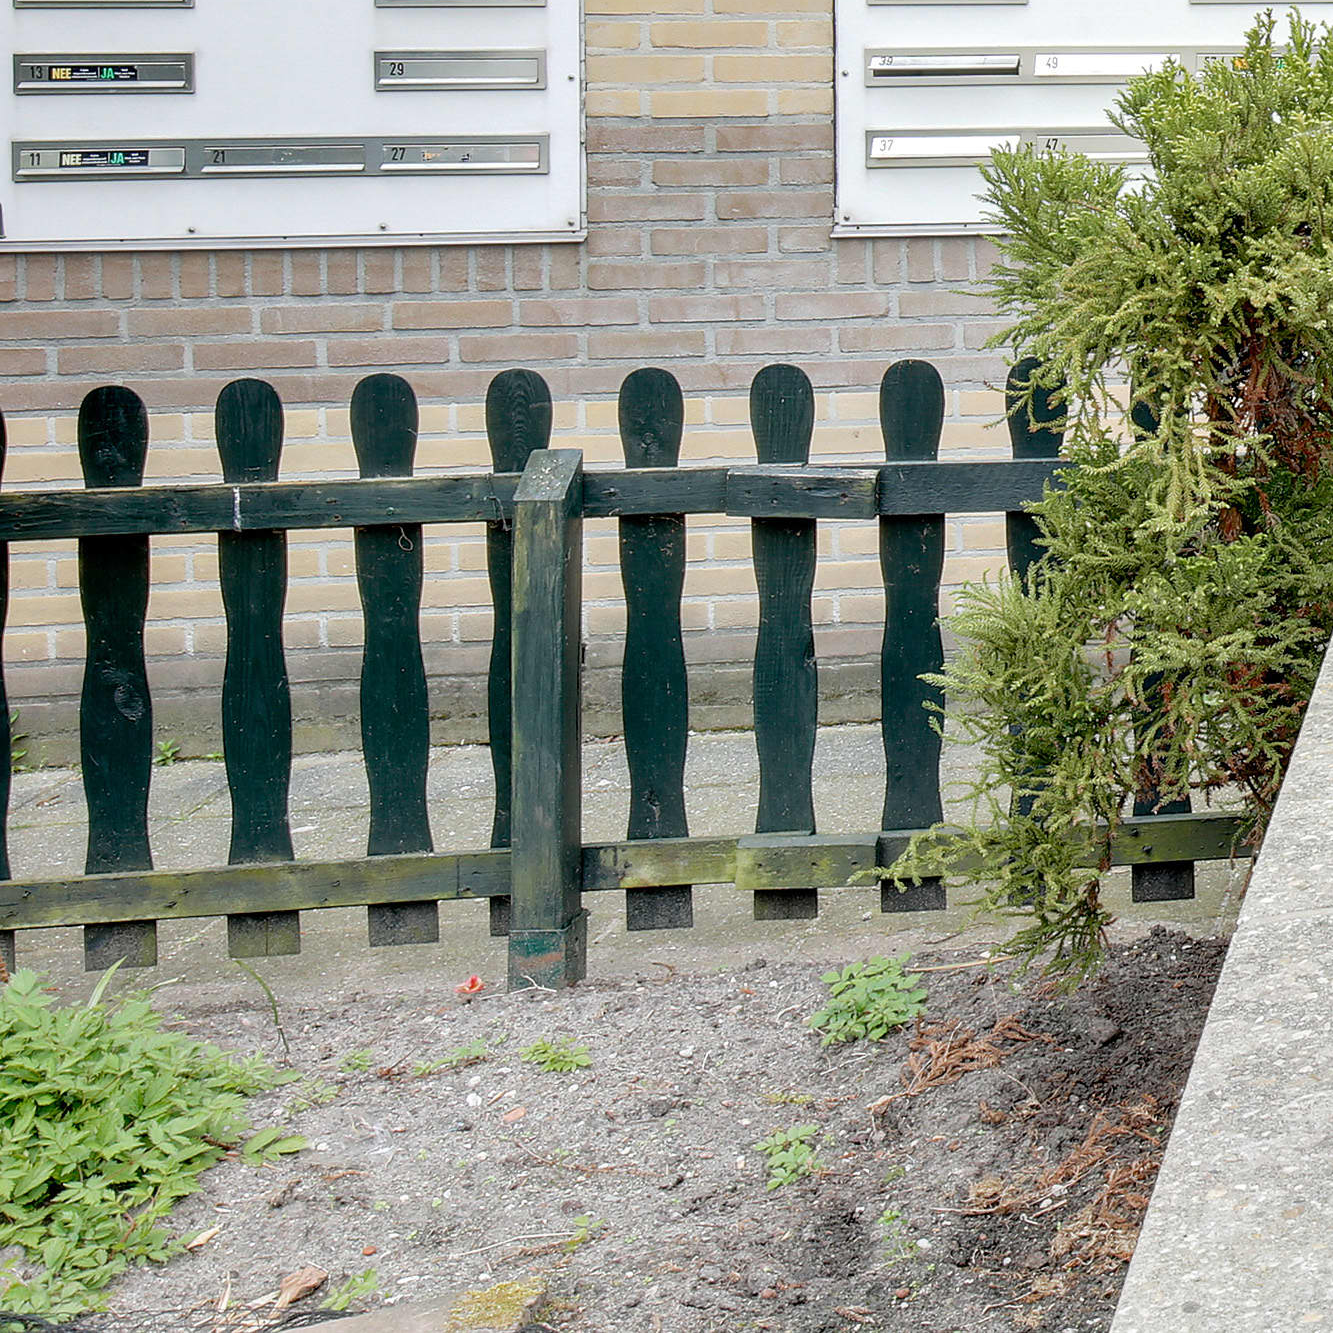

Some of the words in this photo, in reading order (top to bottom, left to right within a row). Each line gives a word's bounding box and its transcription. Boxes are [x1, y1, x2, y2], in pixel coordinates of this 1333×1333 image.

[390, 62, 404, 76] 29
[1046, 56, 1059, 69] 49
[30, 66, 43, 79] 13
[52, 67, 72, 79] NEE
[101, 67, 115, 79] JA
[1045, 138, 1058, 151] 47
[30, 153, 41, 166] 11
[62, 153, 82, 166] NEE
[110, 151, 125, 164] JA
[212, 151, 225, 163] 21
[391, 147, 406, 161] 27
